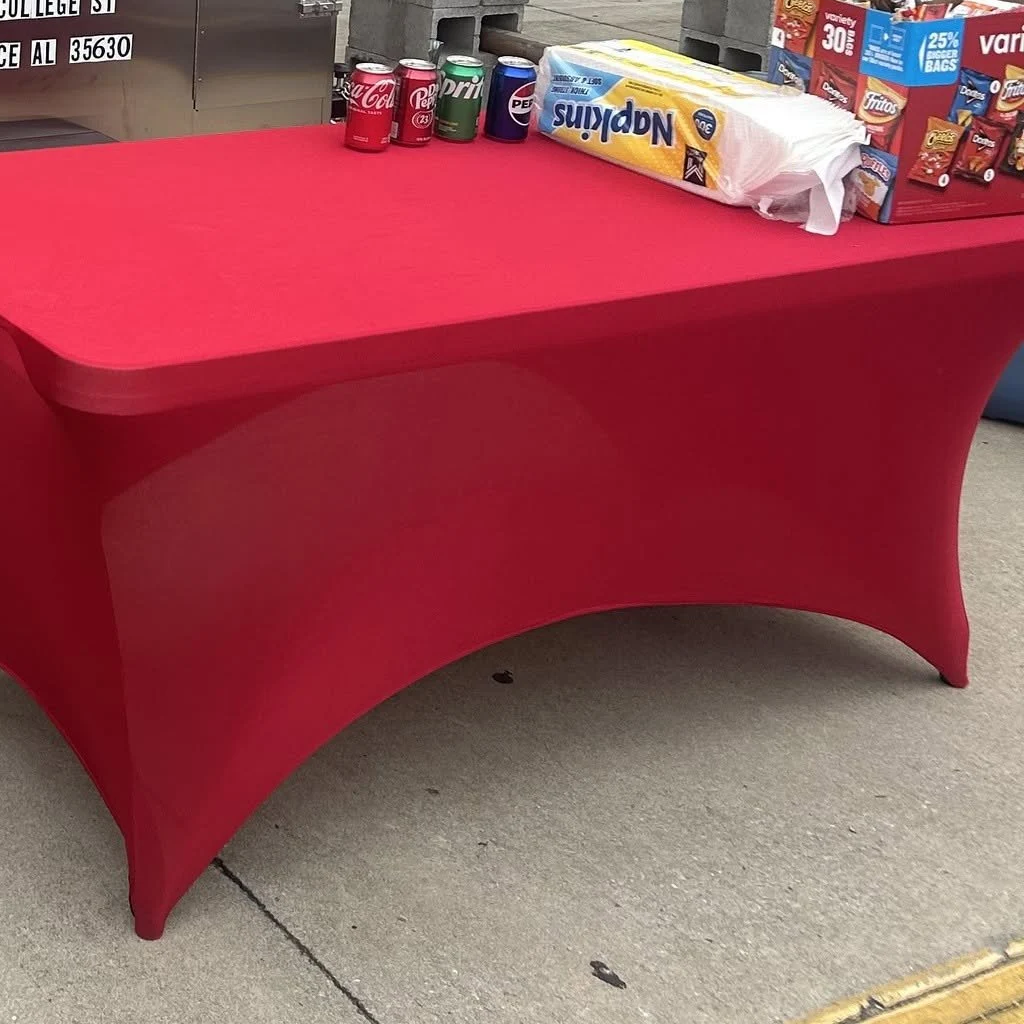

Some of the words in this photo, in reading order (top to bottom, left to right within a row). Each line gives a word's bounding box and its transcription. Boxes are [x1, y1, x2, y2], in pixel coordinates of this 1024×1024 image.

[824, 12, 857, 29] variety
[822, 23, 846, 54] 30
[928, 31, 960, 49] 25%
[33, 40, 55, 66] AL
[71, 36, 131, 62] 35630
[926, 50, 958, 60] BIGGER
[925, 59, 959, 73] BAGS
[822, 81, 848, 104] Doritos
[960, 85, 985, 101] Doritos
[864, 92, 897, 115] Fritos
[419, 115, 429, 125] 23
[553, 101, 673, 147] Napkins
[972, 134, 996, 149] Doritos
